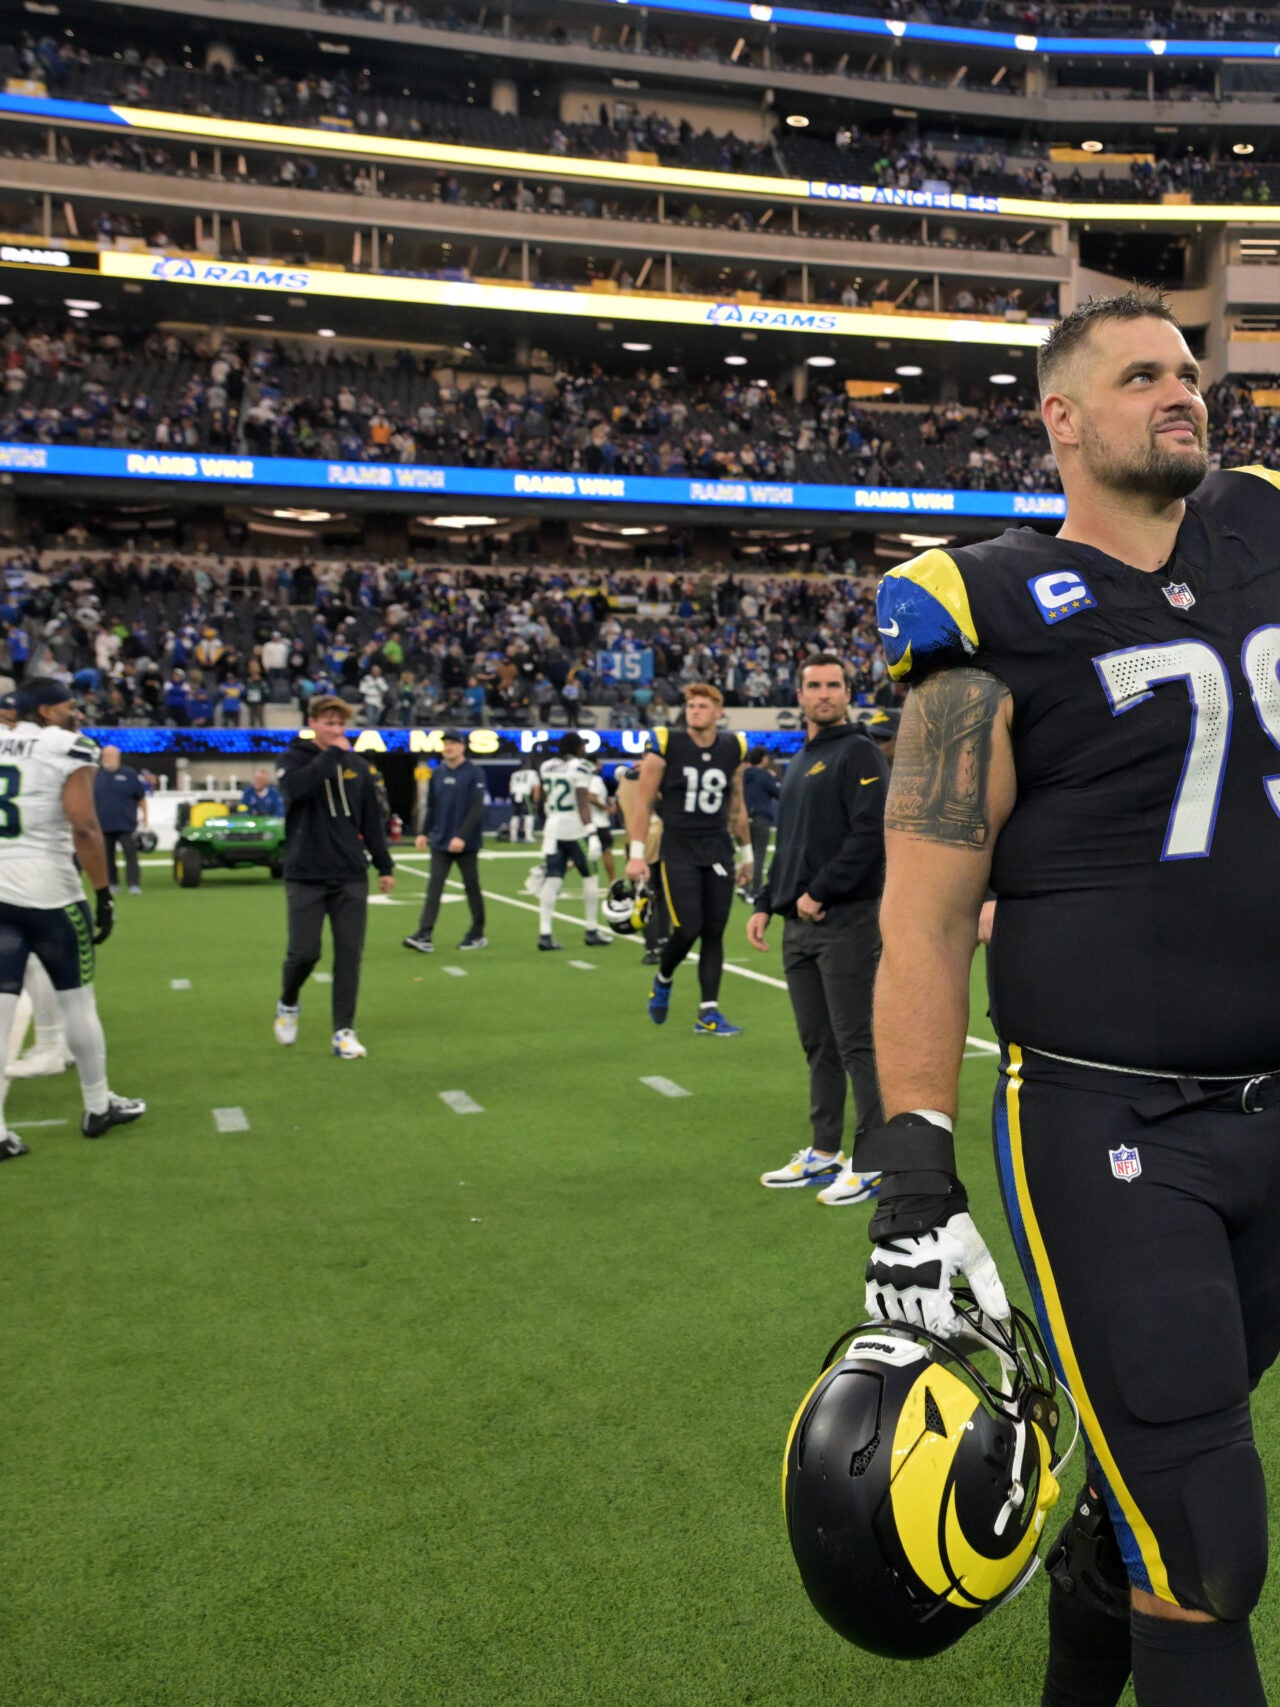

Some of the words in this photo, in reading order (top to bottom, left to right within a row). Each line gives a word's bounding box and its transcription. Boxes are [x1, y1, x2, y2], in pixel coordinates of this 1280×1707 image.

[809, 181, 861, 200] LOS
[872, 188, 1000, 212] ANGELES
[203, 267, 310, 289] RAMS
[749, 311, 837, 331] RAMS
[855, 490, 911, 509] RAMS
[1034, 571, 1087, 608] C
[1170, 592, 1191, 606] NFL
[682, 766, 728, 814] 18
[1116, 1160, 1138, 1176] NFL
[853, 1341, 895, 1354] RAMS
